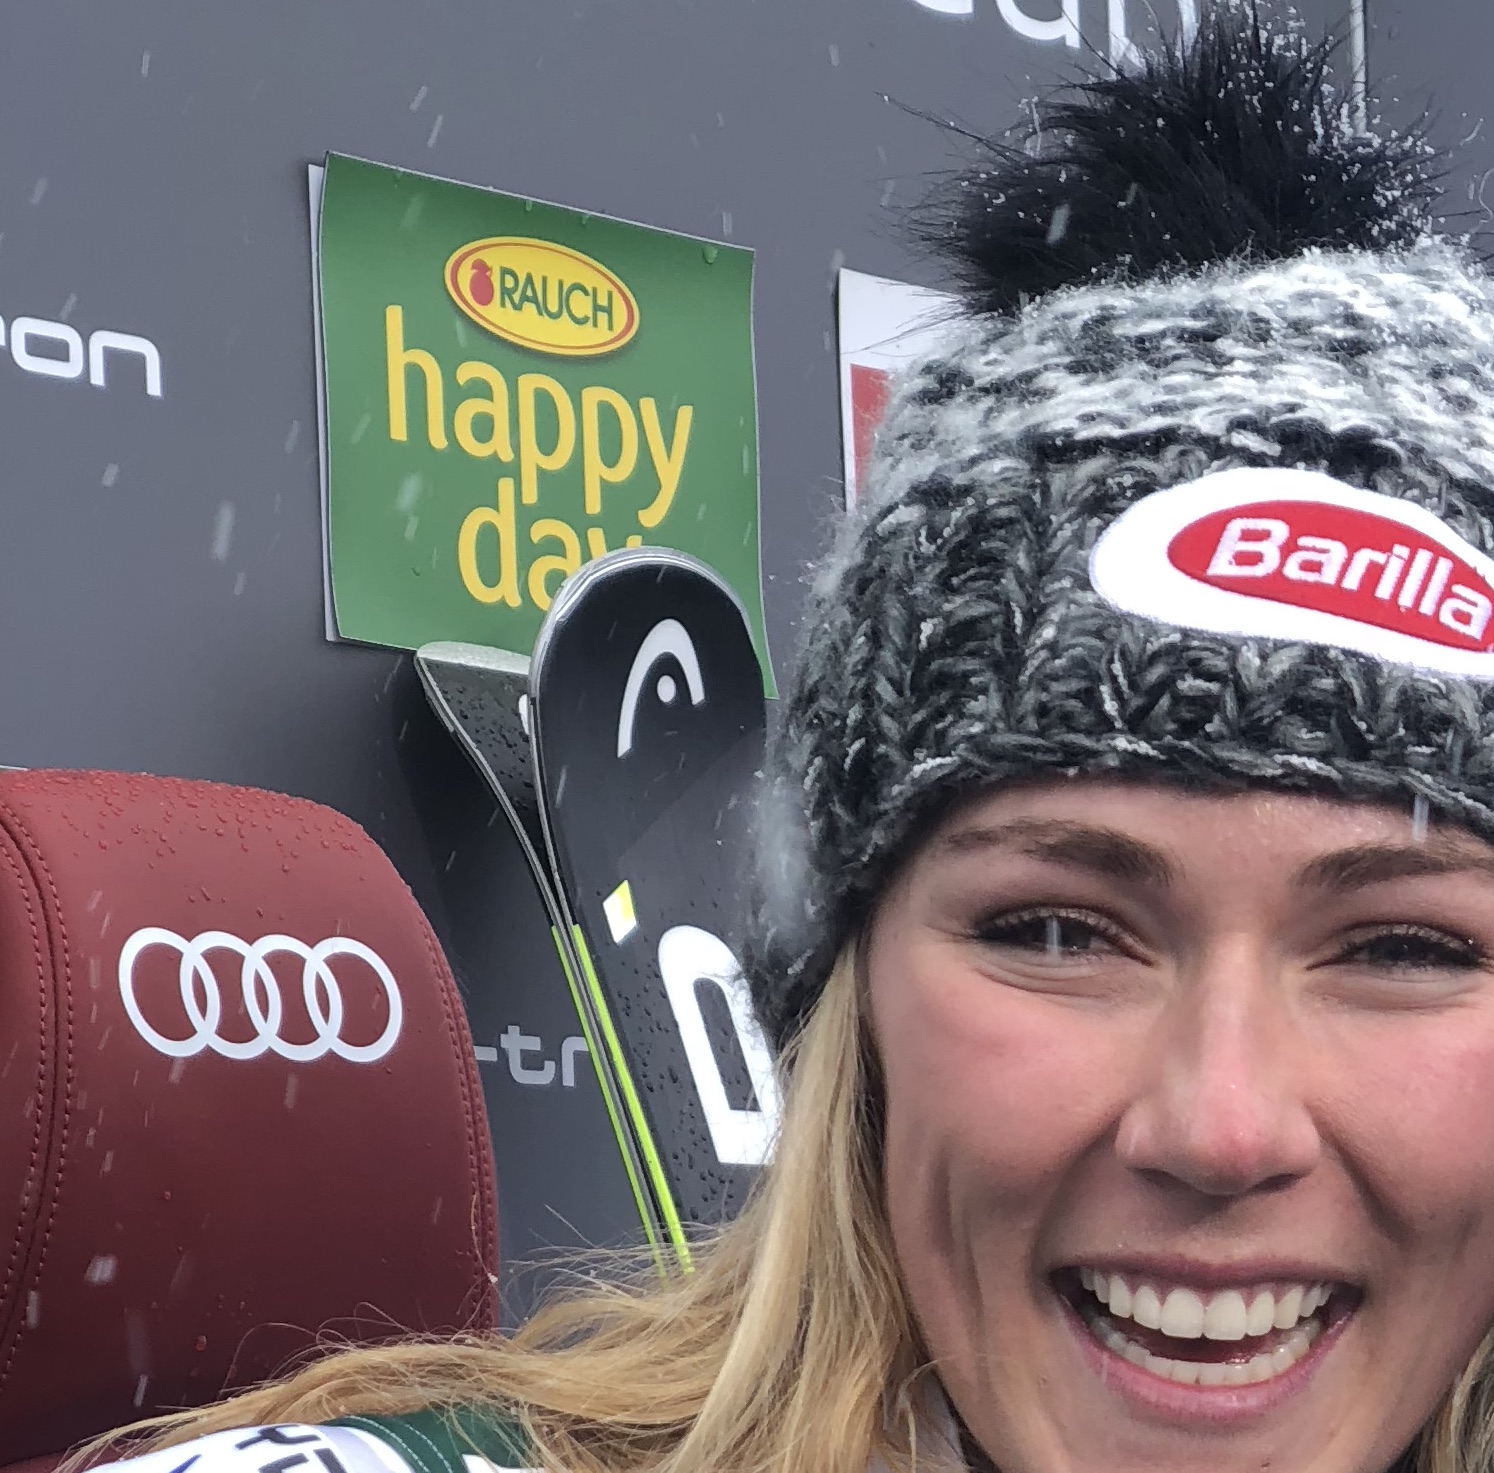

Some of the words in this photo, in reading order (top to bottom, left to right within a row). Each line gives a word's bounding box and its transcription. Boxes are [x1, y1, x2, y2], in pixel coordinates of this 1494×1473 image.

[499, 266, 615, 333] RAUCH
[0, 316, 163, 398] on
[385, 304, 695, 529] happy
[1206, 516, 1494, 642] Barilla
